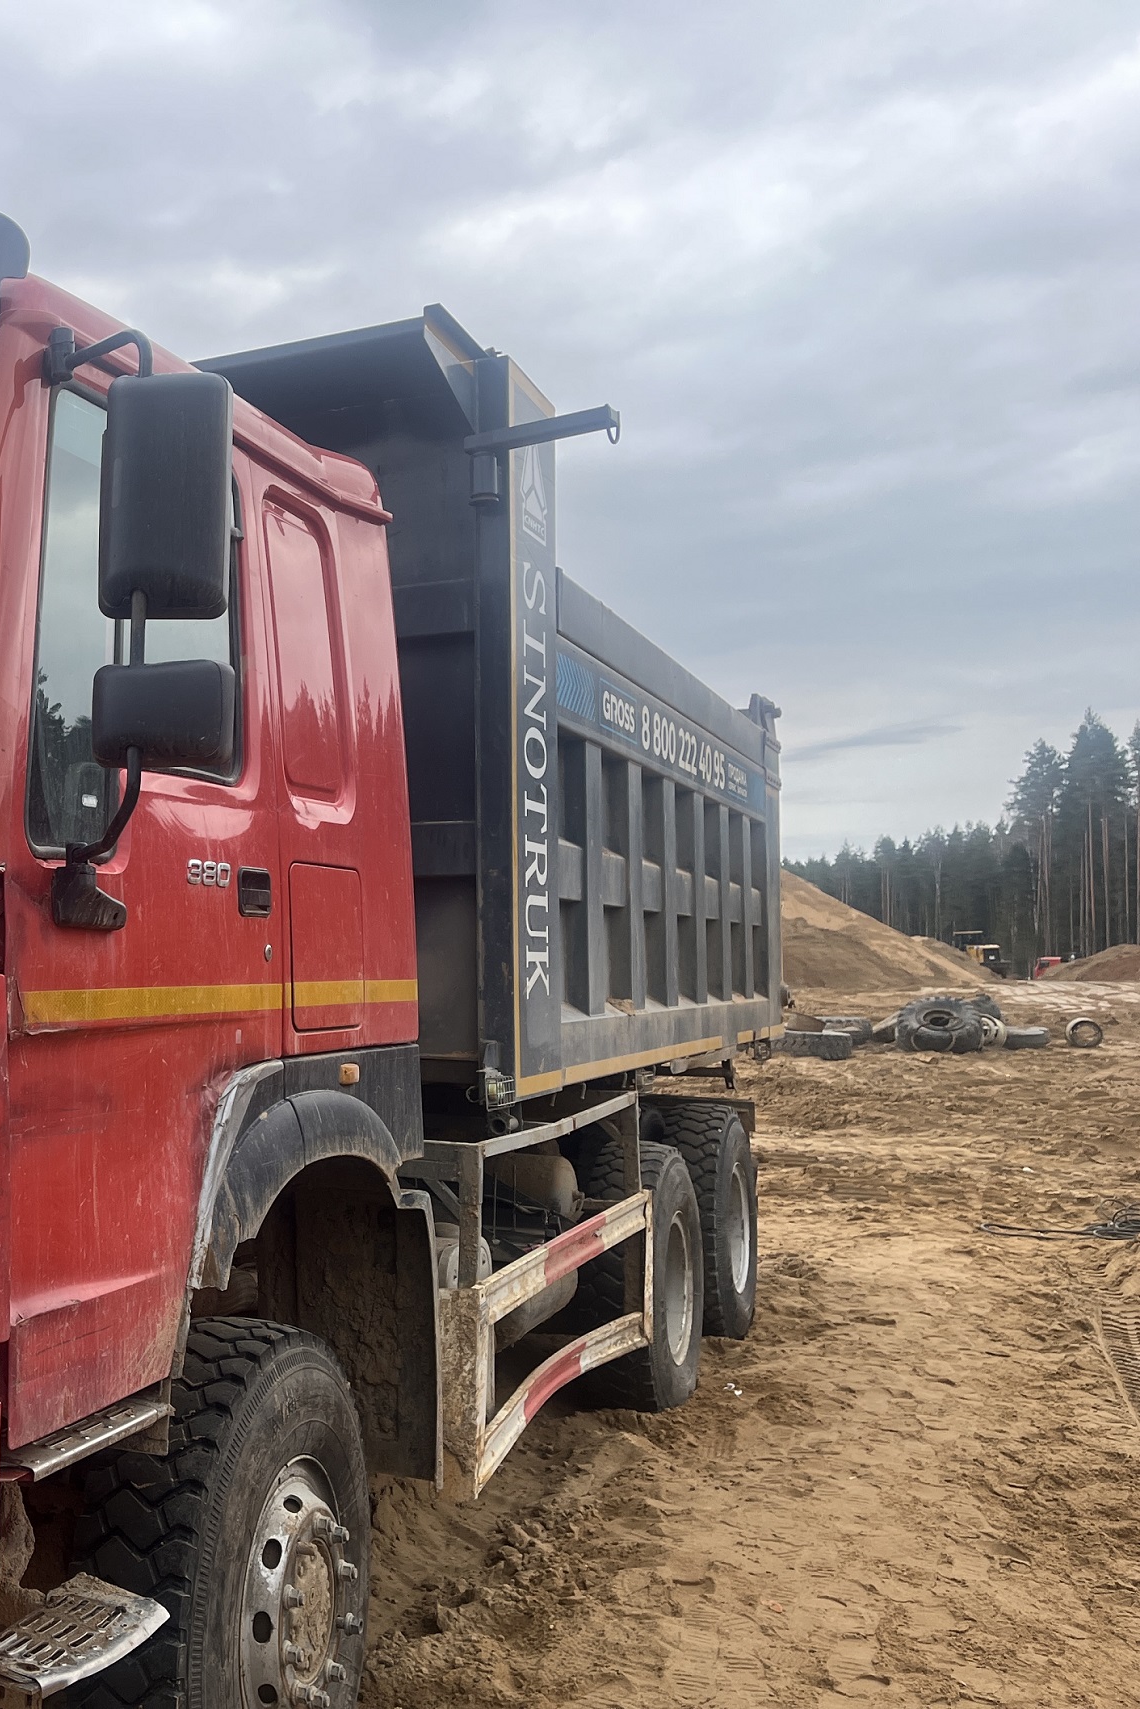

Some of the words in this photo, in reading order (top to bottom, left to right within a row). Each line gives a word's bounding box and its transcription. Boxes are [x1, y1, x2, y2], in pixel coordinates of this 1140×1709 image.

[603, 691, 635, 733] GROSS
[642, 705, 651, 751] 8
[653, 712, 676, 764] 800
[678, 728, 697, 775] 222
[699, 742, 712, 783] 40
[714, 750, 725, 790] 95
[523, 561, 549, 1000] SINOTRUK
[188, 858, 231, 887] 380
